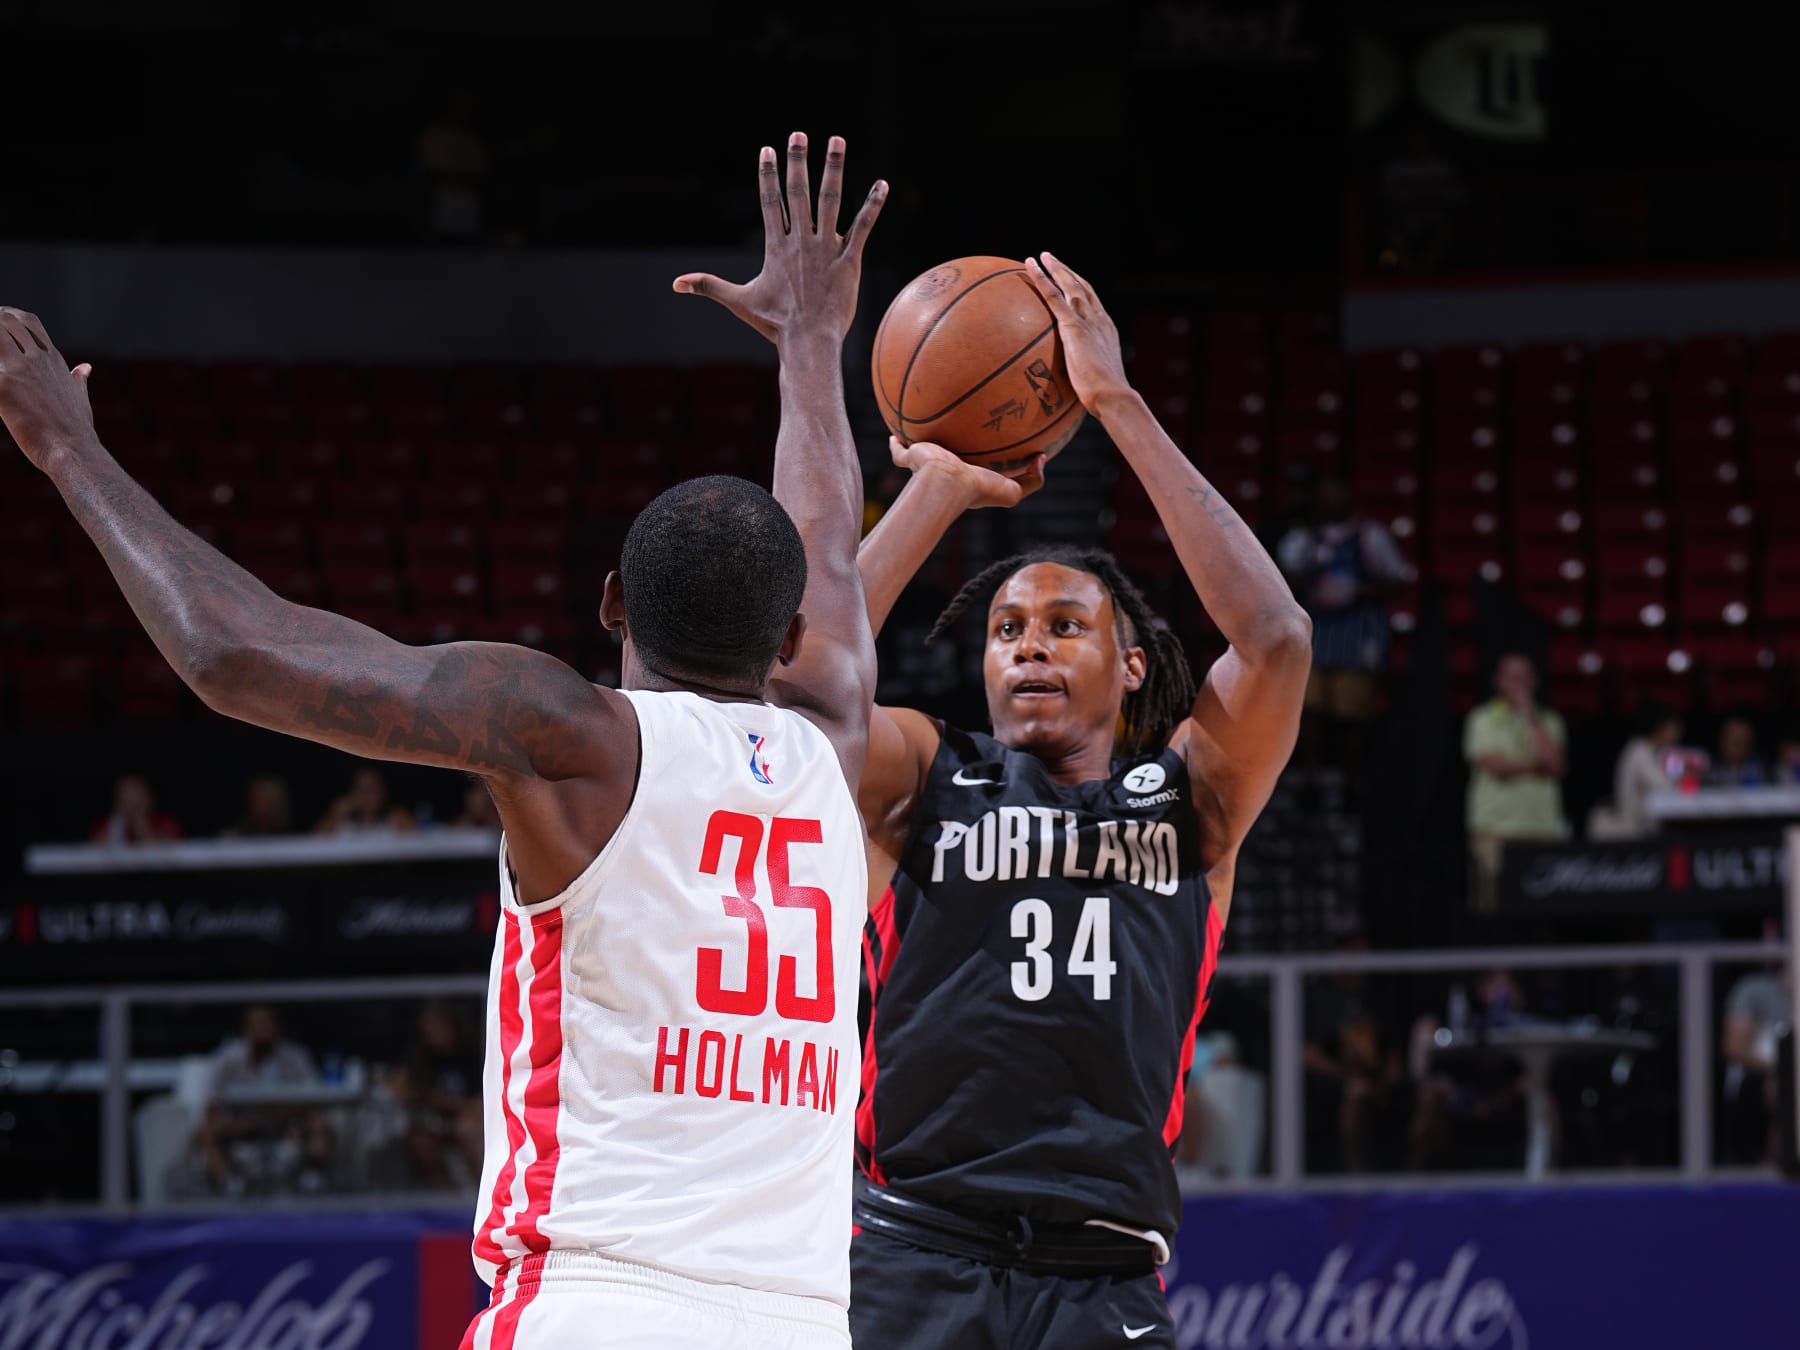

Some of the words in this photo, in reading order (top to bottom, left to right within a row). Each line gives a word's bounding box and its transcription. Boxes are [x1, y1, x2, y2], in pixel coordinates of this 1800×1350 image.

[1126, 788, 1180, 809] StormX
[931, 806, 1180, 897] PORTLAND
[695, 808, 836, 1024] 35
[1010, 897, 1117, 1002] 34
[652, 1025, 839, 1116] HOLMAN
